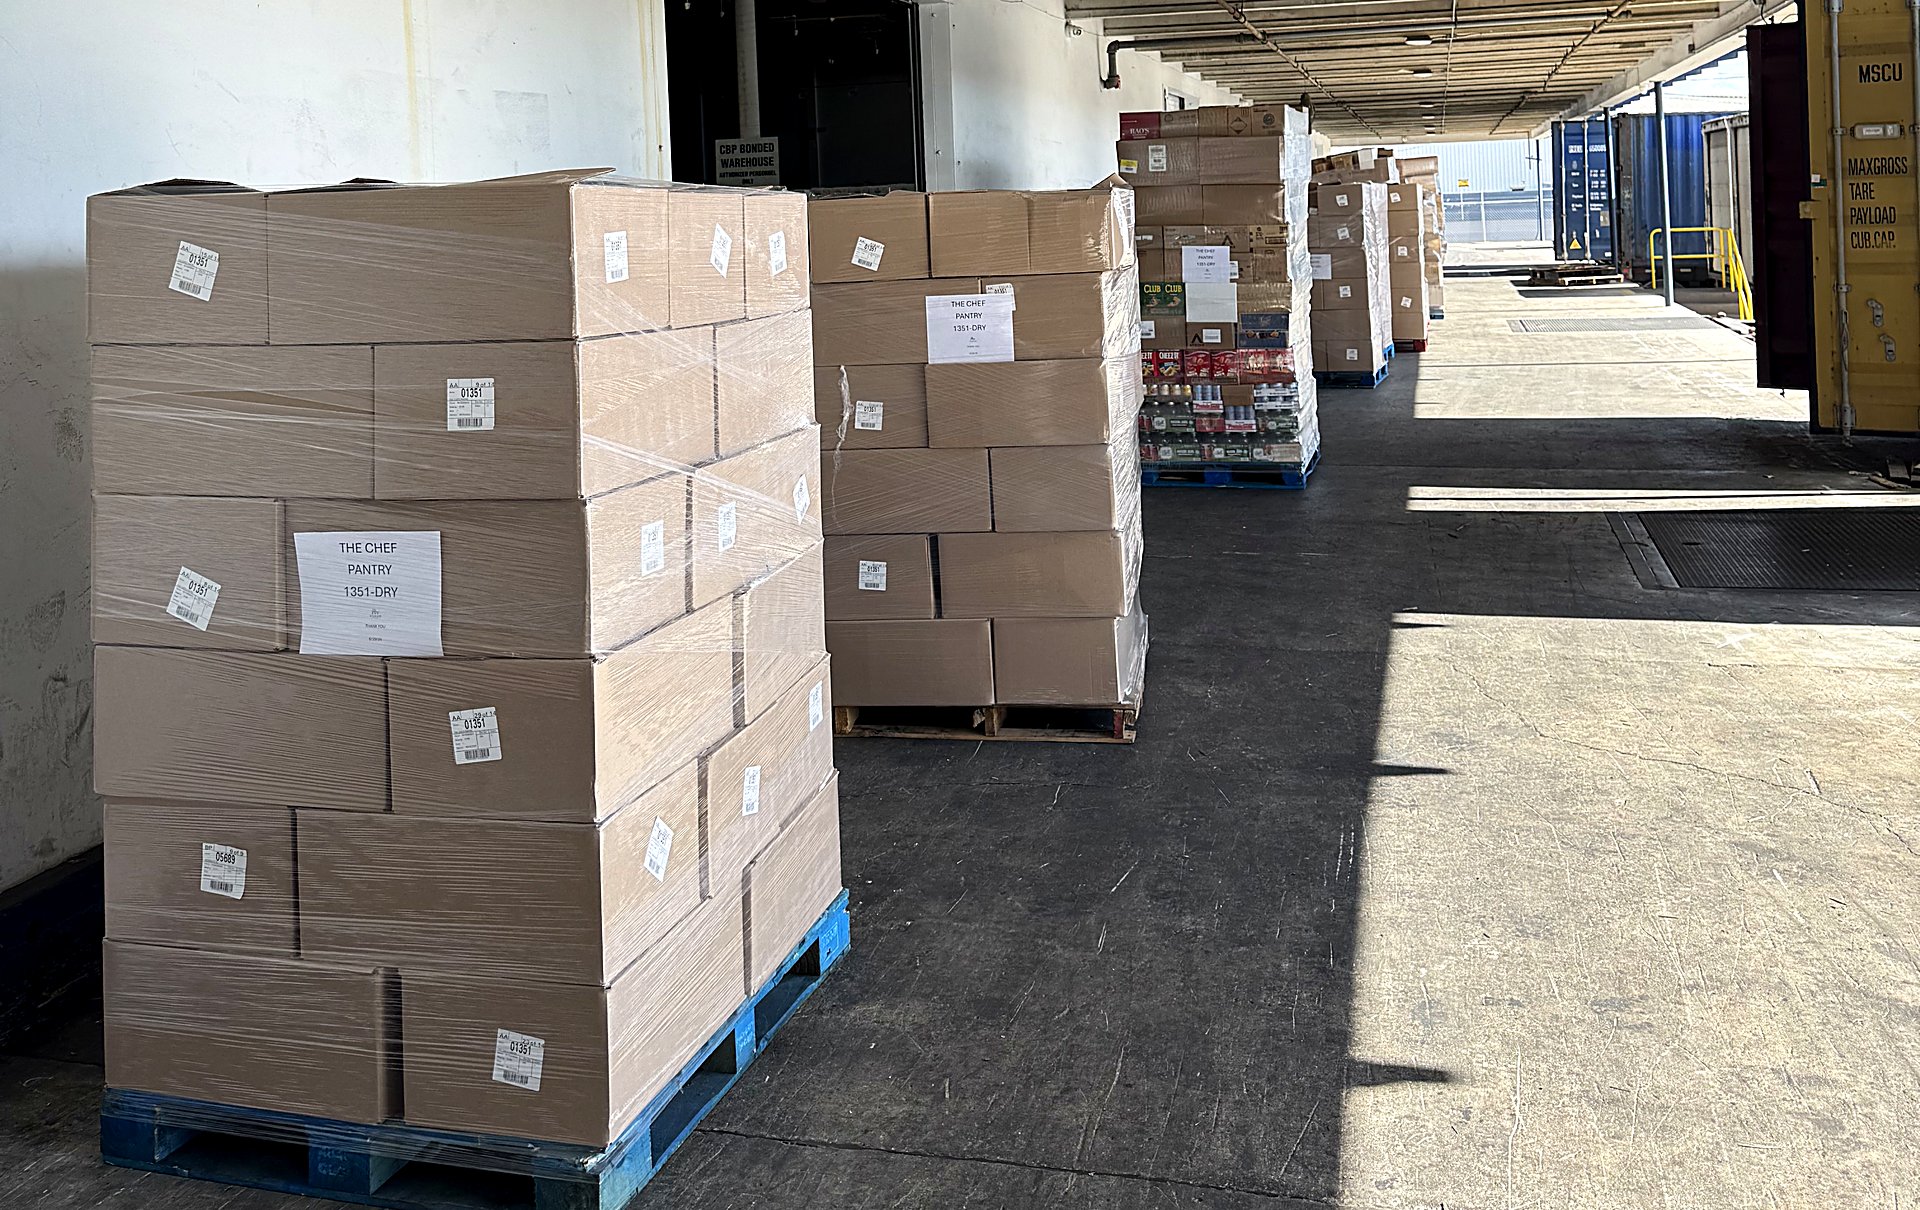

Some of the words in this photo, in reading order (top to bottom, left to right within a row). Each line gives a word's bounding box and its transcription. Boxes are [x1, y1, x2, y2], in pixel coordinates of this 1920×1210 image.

[1858, 62, 1903, 84] MSCU
[719, 144, 737, 155] CBP
[739, 142, 775, 154] BONDED
[720, 156, 775, 169] WAREHOUSE
[1847, 156, 1908, 177] MAXGROSS
[1848, 182, 1876, 201] TARE
[1849, 206, 1897, 226] PAYLOAD
[1850, 231, 1896, 250] CUB.CAP.
[188, 253, 208, 268] 01351
[1143, 284, 1162, 293] CLUB
[1165, 284, 1183, 293] CLUB
[955, 312, 983, 320] PANTRY
[953, 324, 987, 332] 1351-DRY
[461, 388, 482, 398] 01351
[339, 542, 362, 554] THE
[364, 542, 398, 554] CHEF
[347, 564, 392, 576] PANTRY
[188, 580, 208, 597] 01351
[343, 586, 399, 598] 1351-DRY
[464, 718, 486, 730] 01351
[215, 851, 236, 865] 05689
[510, 1041, 531, 1056] 01351
